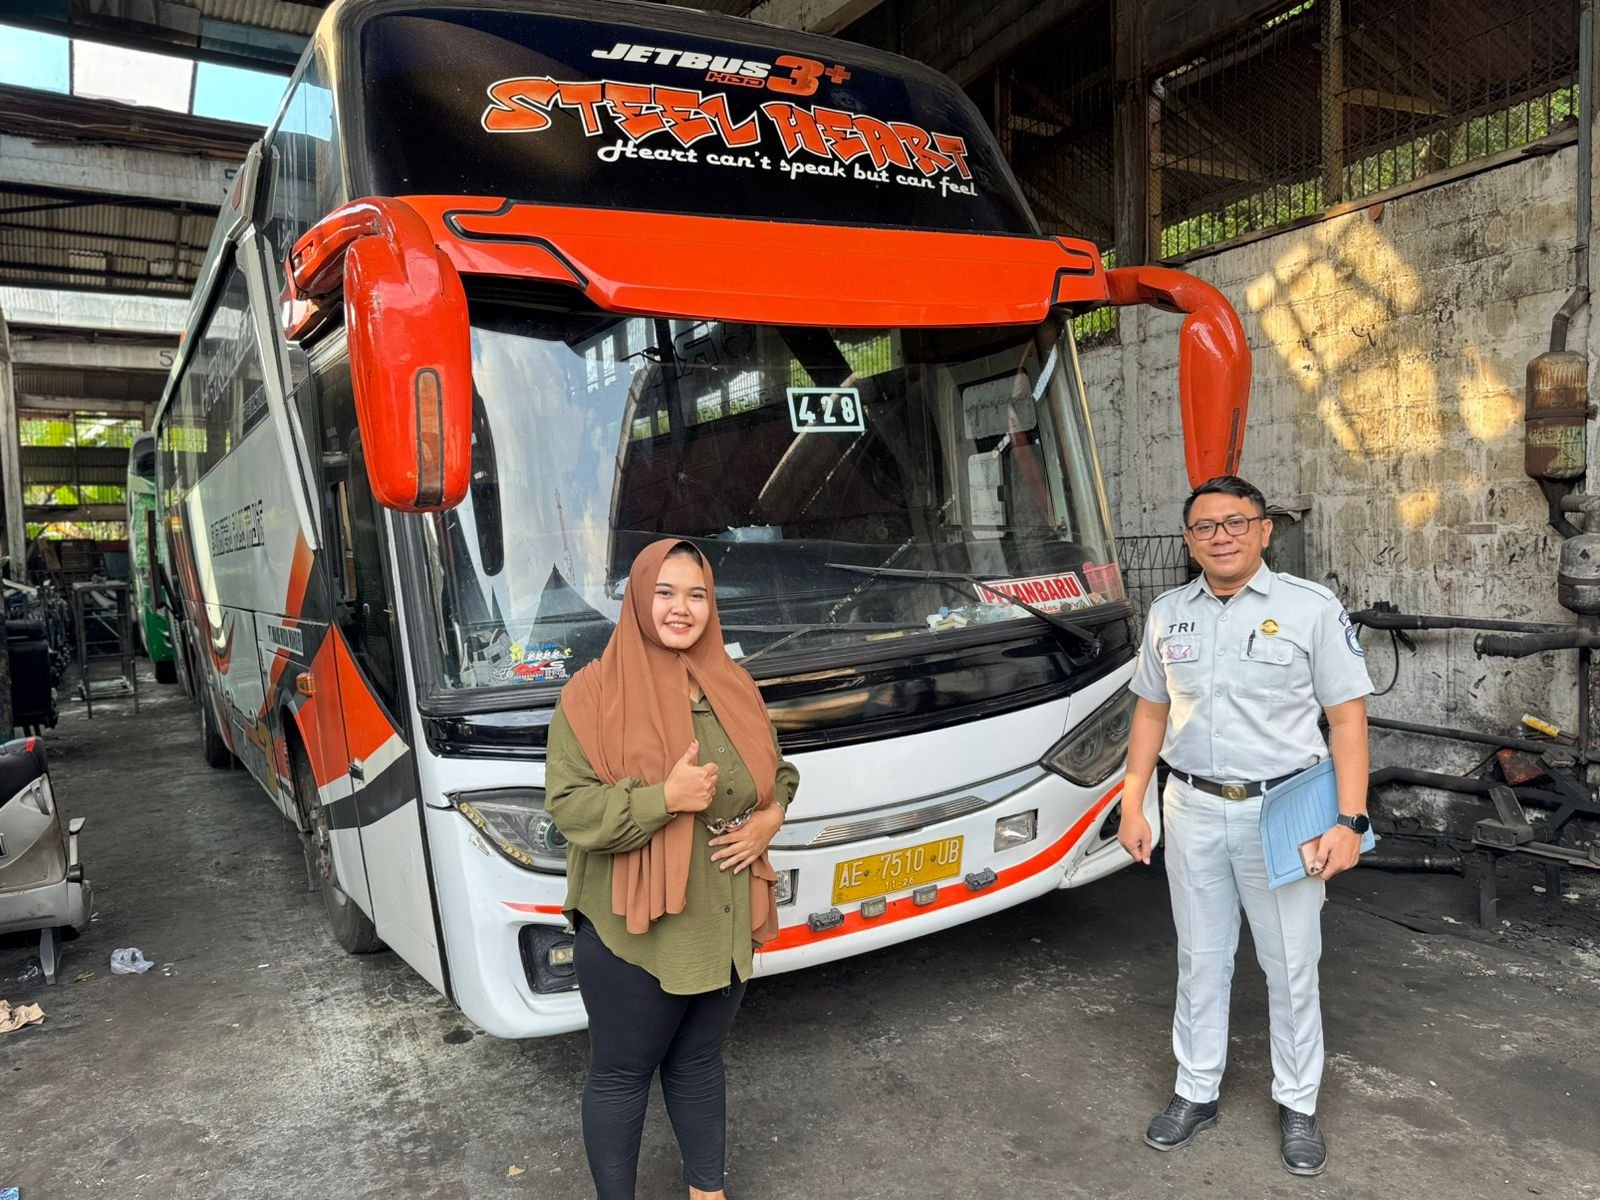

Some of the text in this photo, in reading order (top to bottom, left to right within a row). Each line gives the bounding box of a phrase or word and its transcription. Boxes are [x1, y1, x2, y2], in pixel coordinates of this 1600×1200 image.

[591, 43, 852, 96] JETBUS 3+
[481, 75, 973, 179] STEEL HEART
[597, 139, 978, 197] Heart can't speak but can feel
[799, 396, 856, 424] 428
[1168, 621, 1195, 634] TRI
[839, 839, 960, 888] AE 7510 UB
